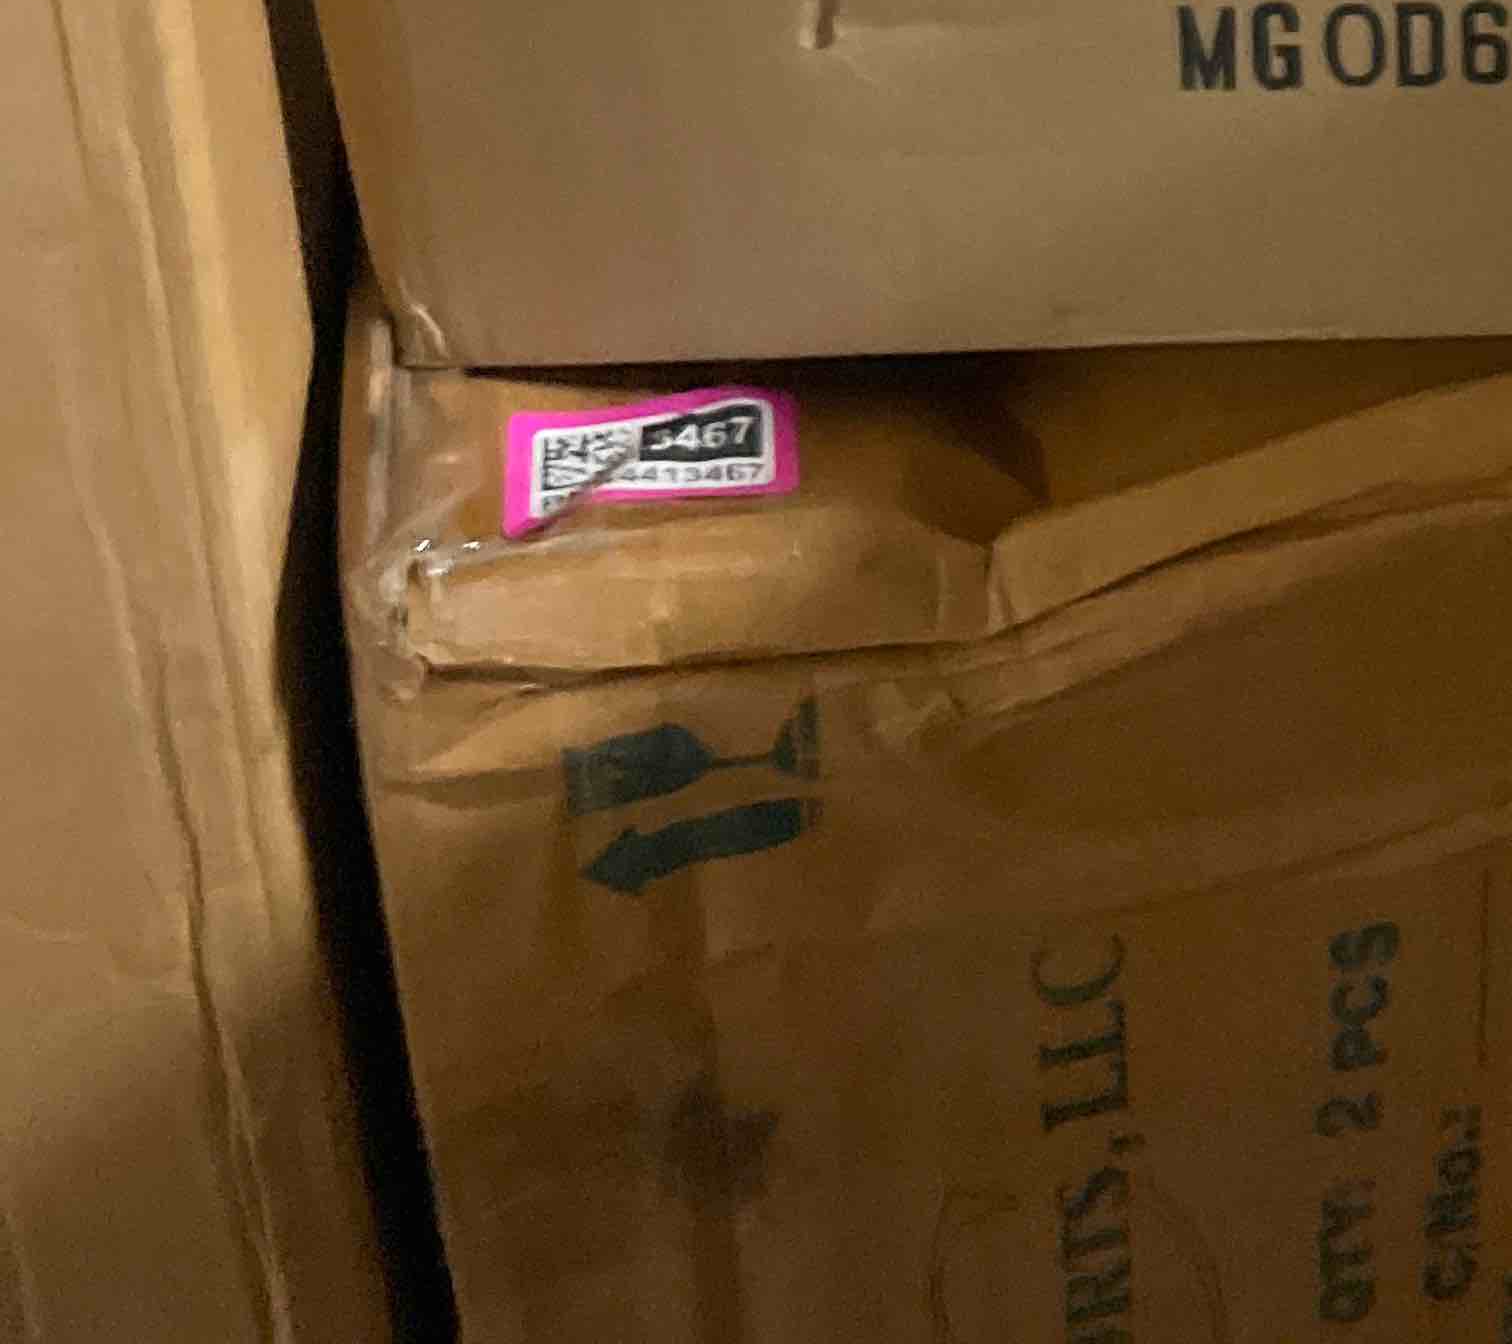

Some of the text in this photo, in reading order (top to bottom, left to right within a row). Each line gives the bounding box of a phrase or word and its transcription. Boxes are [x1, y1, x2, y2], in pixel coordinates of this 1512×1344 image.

[1030, 933, 1128, 1133] LLC
[1328, 921, 1399, 1072] PCS
[1315, 1092, 1381, 1138] 2
